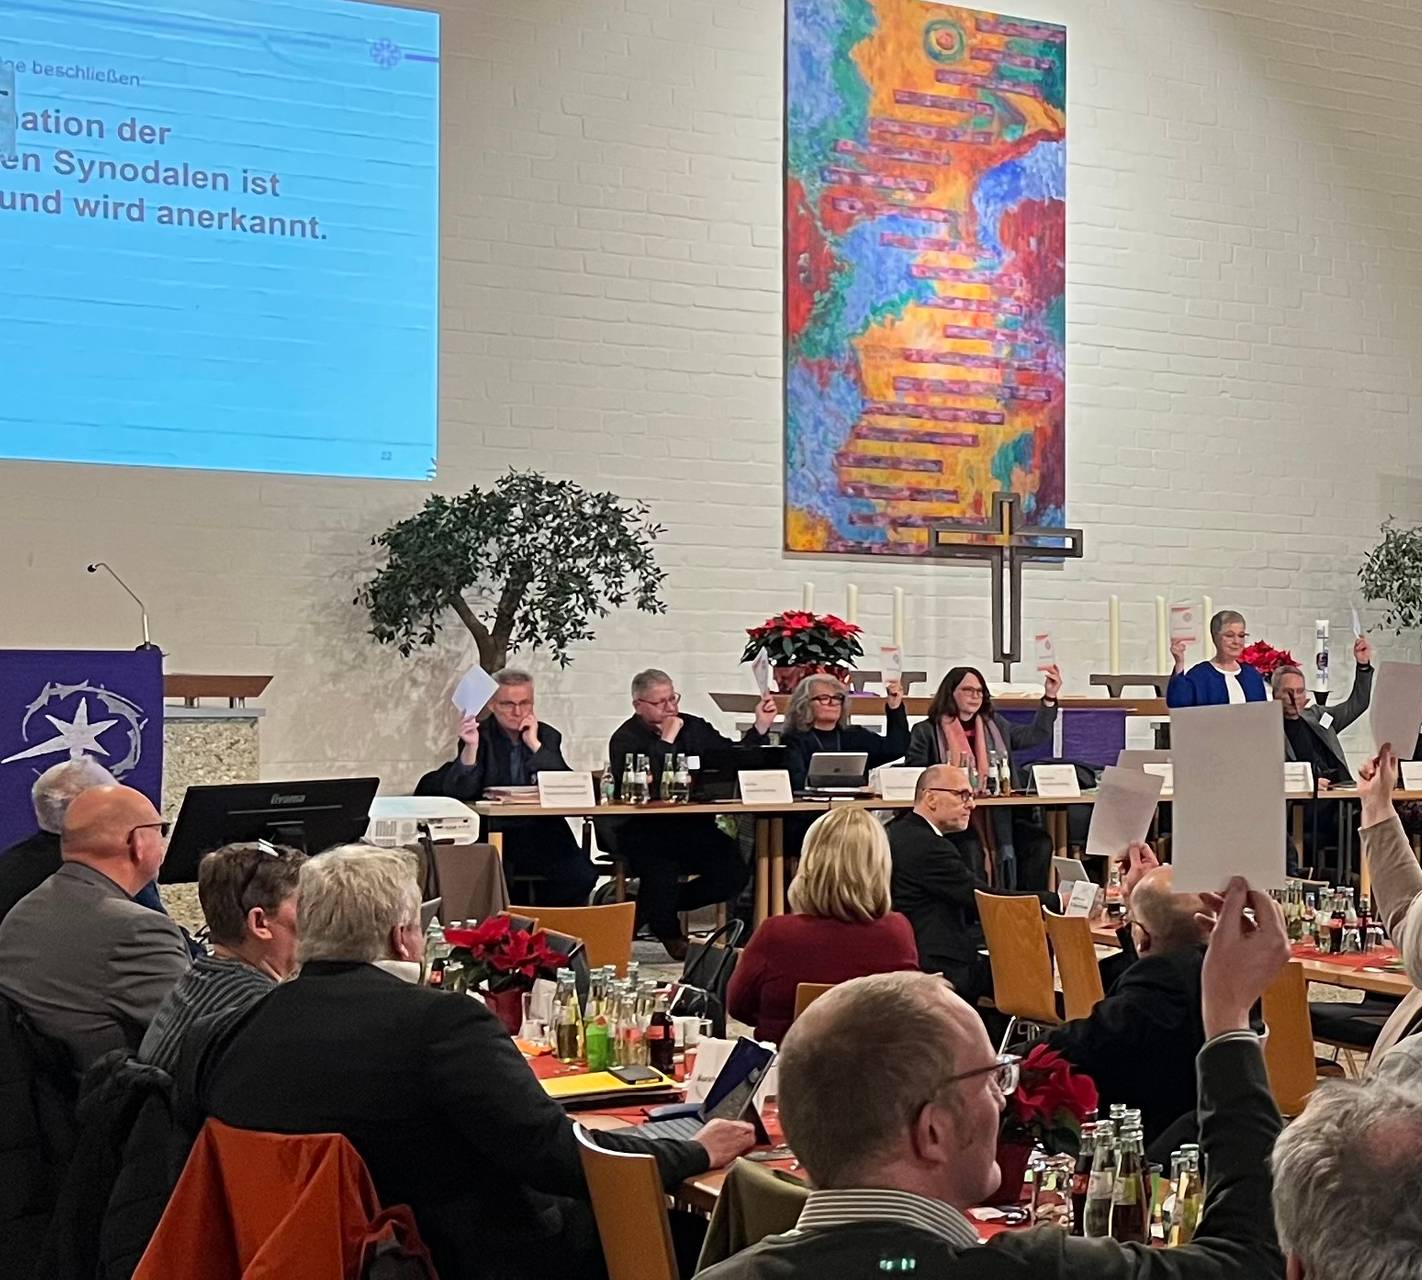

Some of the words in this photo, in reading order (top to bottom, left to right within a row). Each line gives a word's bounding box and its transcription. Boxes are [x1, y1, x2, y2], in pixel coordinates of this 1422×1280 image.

[16, 109, 104, 139] ation
[117, 117, 172, 145] der
[53, 149, 229, 192] Synodalen
[242, 168, 280, 197] ist
[73, 194, 145, 222] wird
[157, 205, 327, 240] anerkannt.
